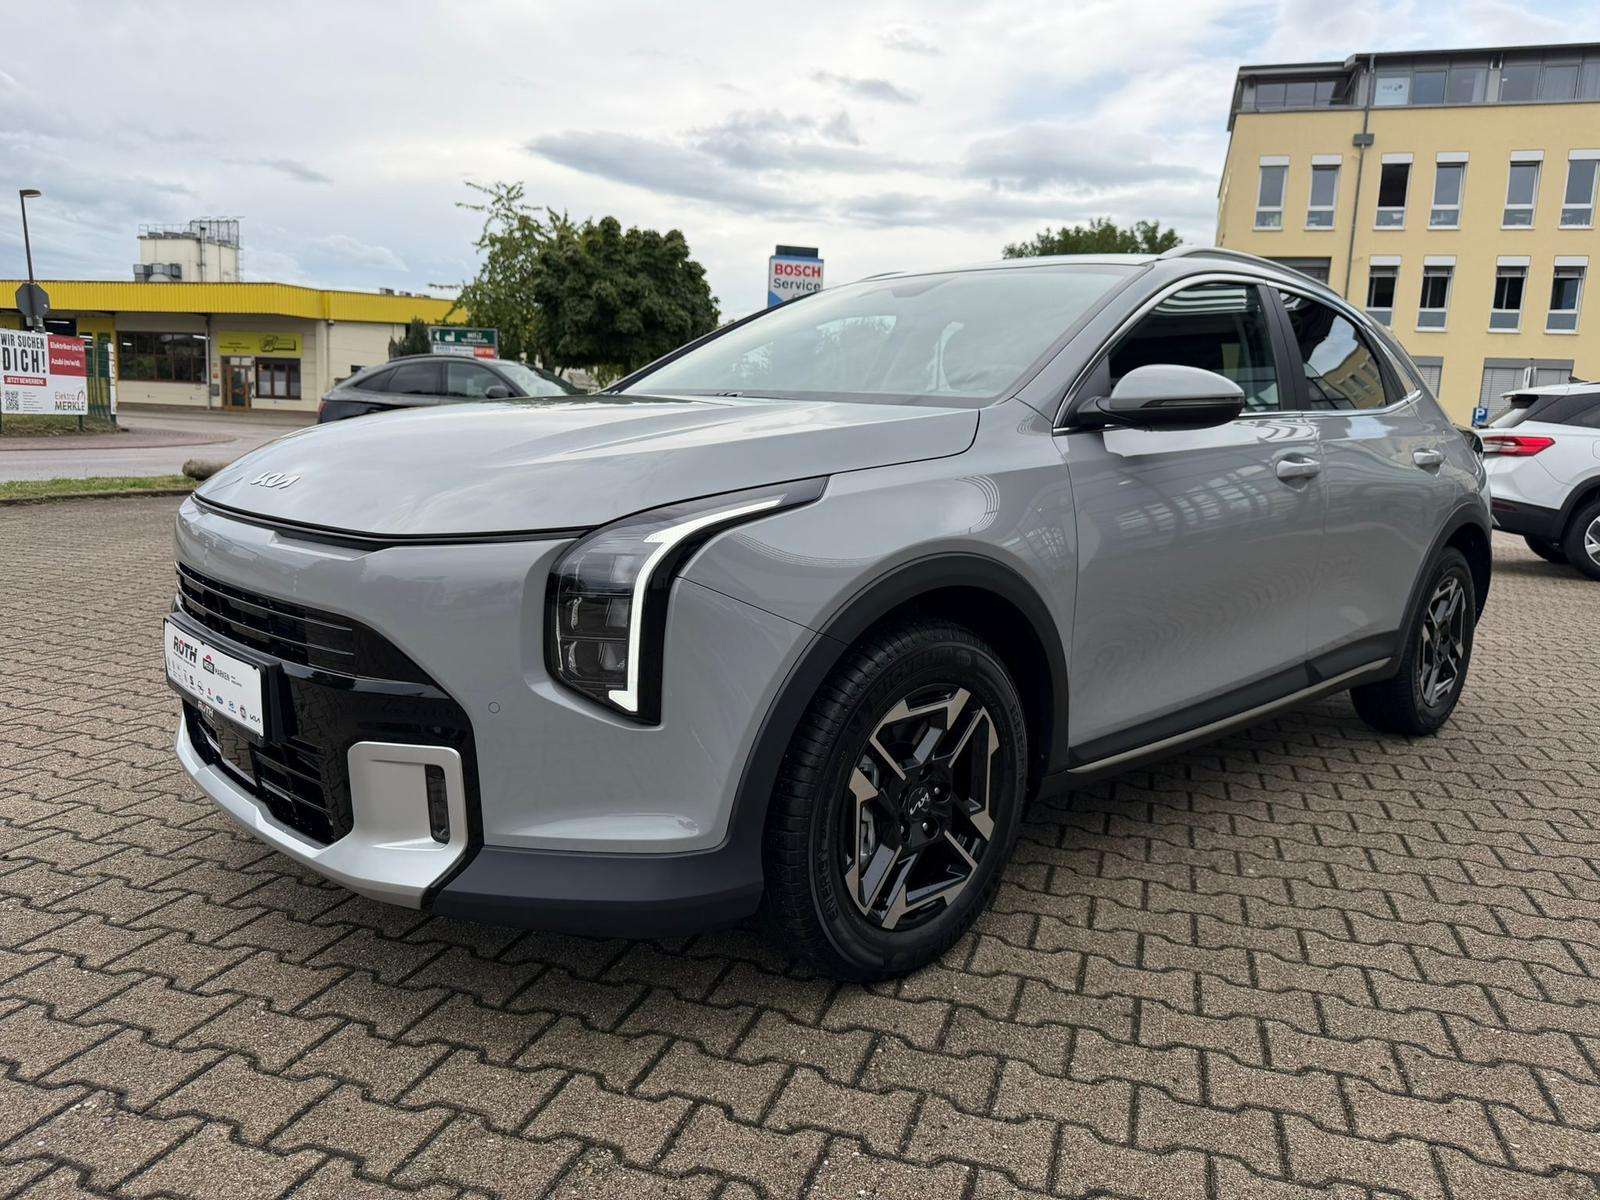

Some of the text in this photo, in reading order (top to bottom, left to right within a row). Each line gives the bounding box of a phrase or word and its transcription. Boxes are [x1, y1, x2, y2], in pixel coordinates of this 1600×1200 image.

[775, 263, 821, 277] BOSCH
[773, 277, 821, 292] Service
[1, 332, 45, 349] WIR SUCHEN
[2, 347, 46, 374] DICH!
[54, 391, 76, 401] Elektro
[54, 401, 85, 411] MERKLE
[1475, 407, 1486, 420] P
[249, 470, 301, 490] KIA
[173, 635, 198, 664] ROTH
